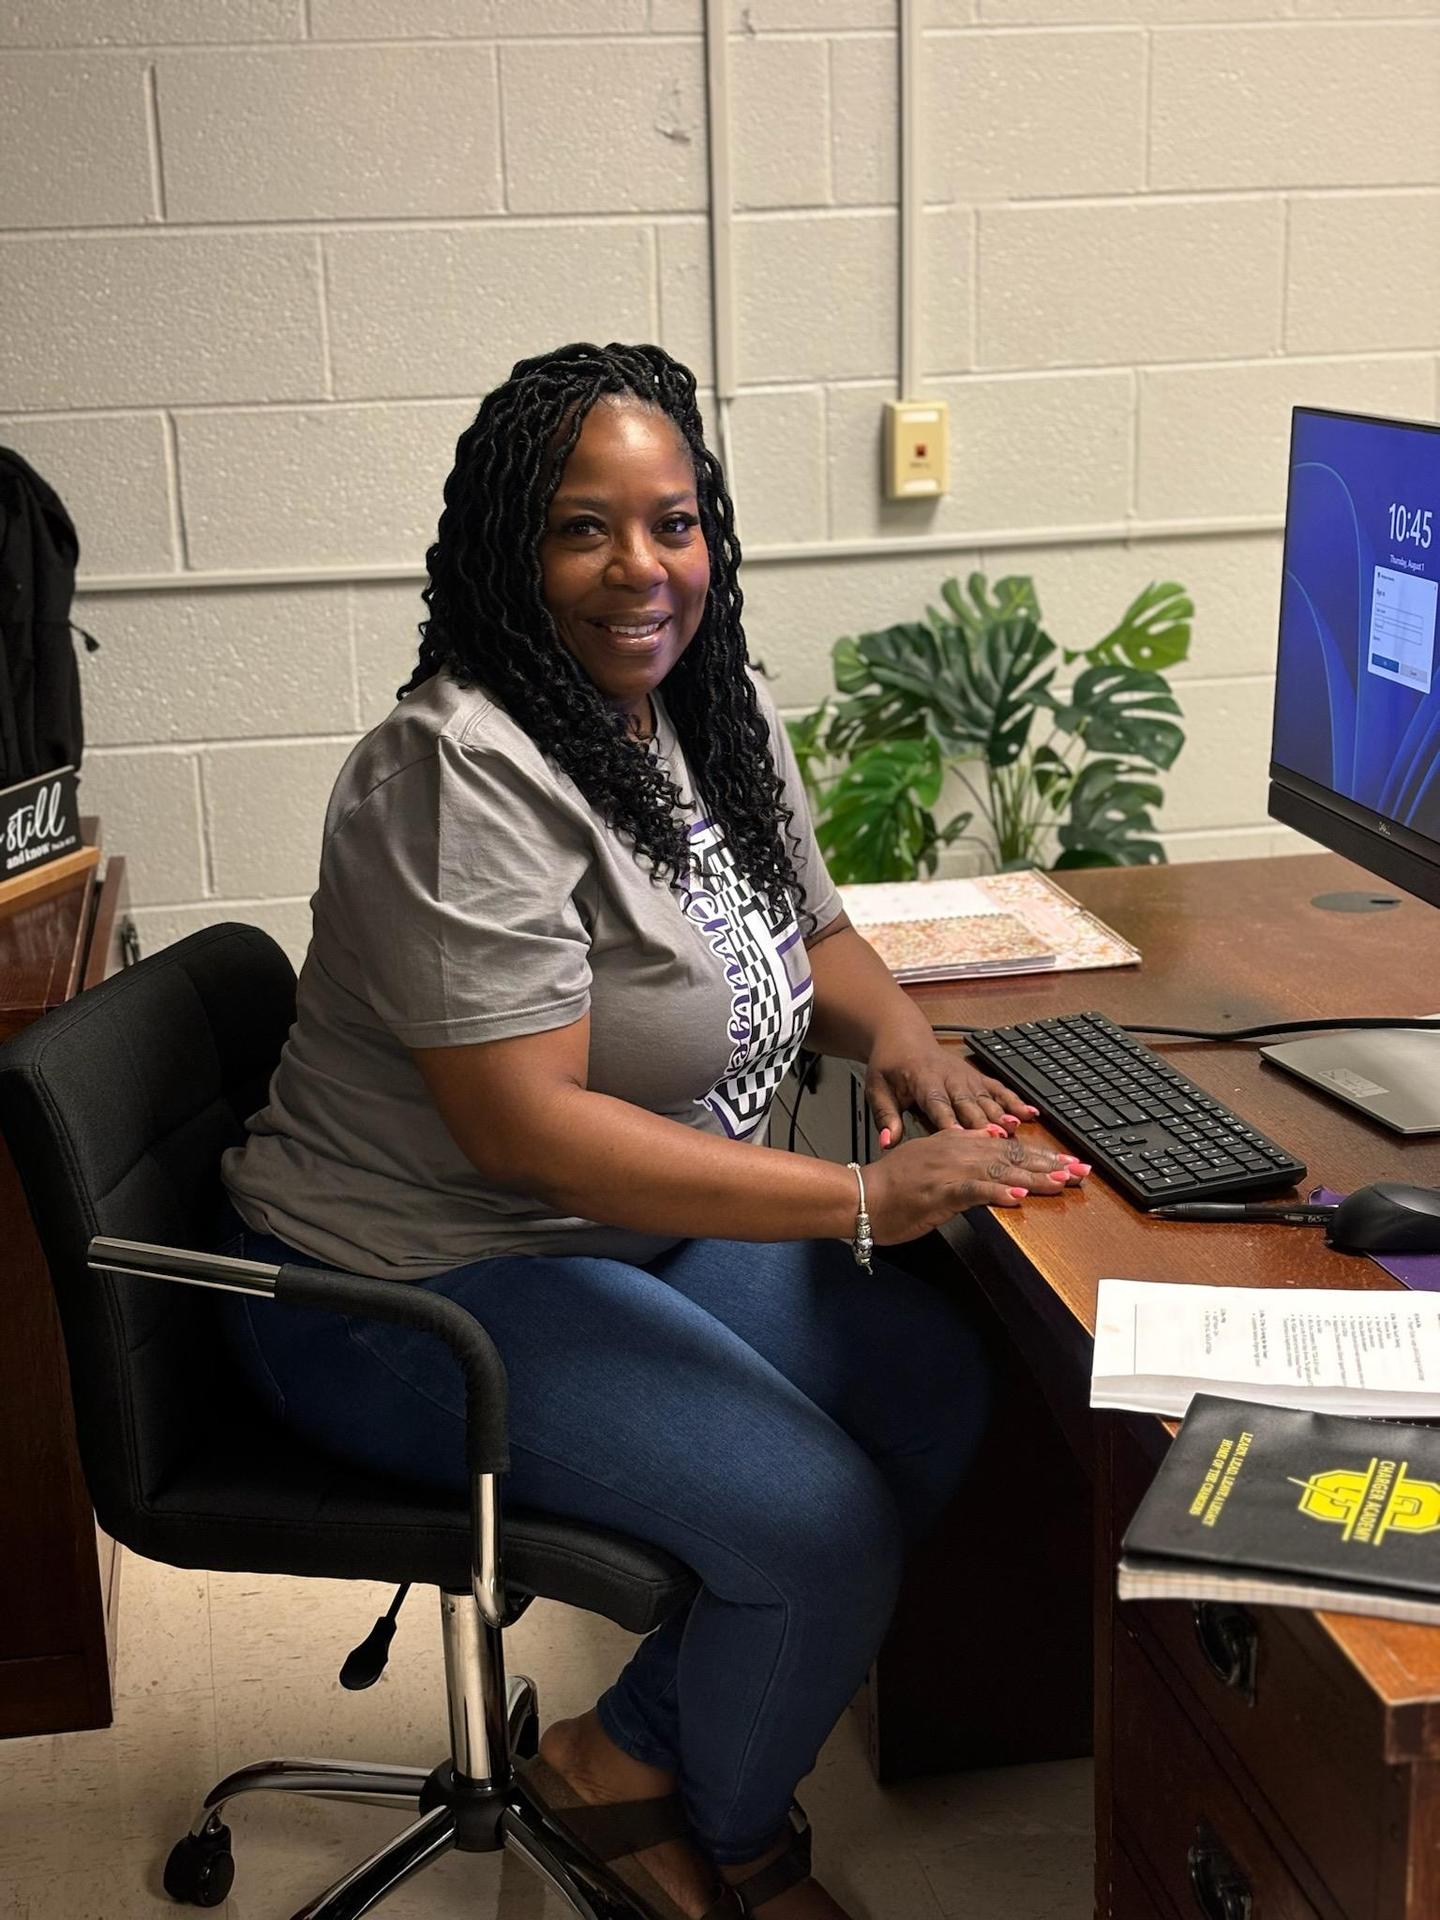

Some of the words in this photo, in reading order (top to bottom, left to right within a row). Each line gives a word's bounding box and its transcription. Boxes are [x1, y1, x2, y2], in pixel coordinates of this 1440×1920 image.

[1389, 503, 1432, 548] 10:45
[6, 781, 66, 851] still
[6, 850, 25, 869] and
[24, 842, 50, 862] know
[1216, 1439, 1234, 1460] HOME
[1205, 1469, 1221, 1483] THE
[1212, 1459, 1225, 1469] OF
[1224, 1456, 1243, 1475] LEAD,
[1217, 1475, 1235, 1497] LEAVE
[1368, 1461, 1396, 1501] CHARGER
[1189, 1482, 1214, 1516] CHARGERS
[1202, 1500, 1223, 1527] LEGACY
[1352, 1499, 1382, 1543] ACADEMY
